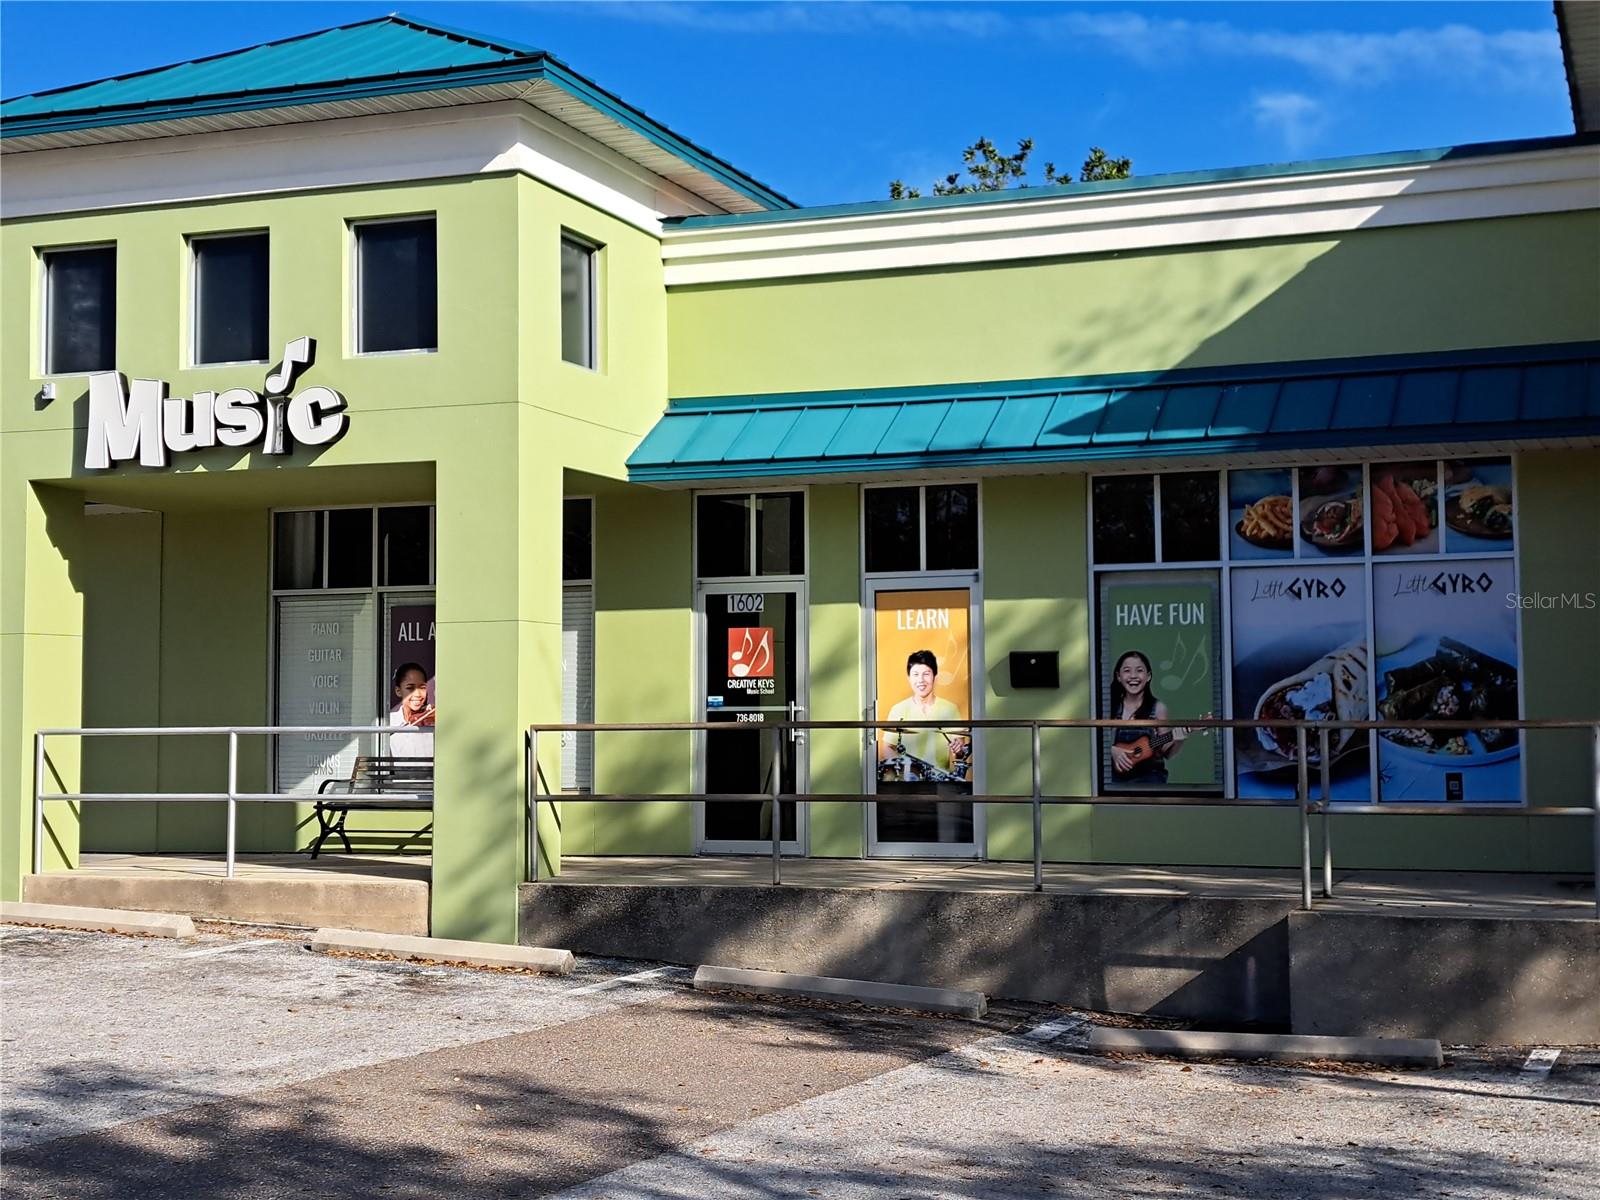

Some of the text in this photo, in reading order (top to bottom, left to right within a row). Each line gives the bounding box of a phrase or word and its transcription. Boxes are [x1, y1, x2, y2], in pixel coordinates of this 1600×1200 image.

[85, 336, 350, 469] Music
[1288, 577, 1346, 601] GYRO
[1431, 571, 1493, 596] GYRO
[730, 594, 763, 612] 1602
[897, 608, 950, 631] LEARN
[1116, 602, 1205, 626] HAVE FUN
[311, 622, 340, 635] PIANO
[398, 622, 424, 642] ALL
[307, 649, 342, 662] GUITAR
[312, 675, 339, 688] VOICE
[727, 679, 775, 689] CREATIVE KEYS
[309, 702, 340, 714] VIOLIN
[736, 713, 764, 722] 736-8018
[307, 754, 341, 768] DRUMS
